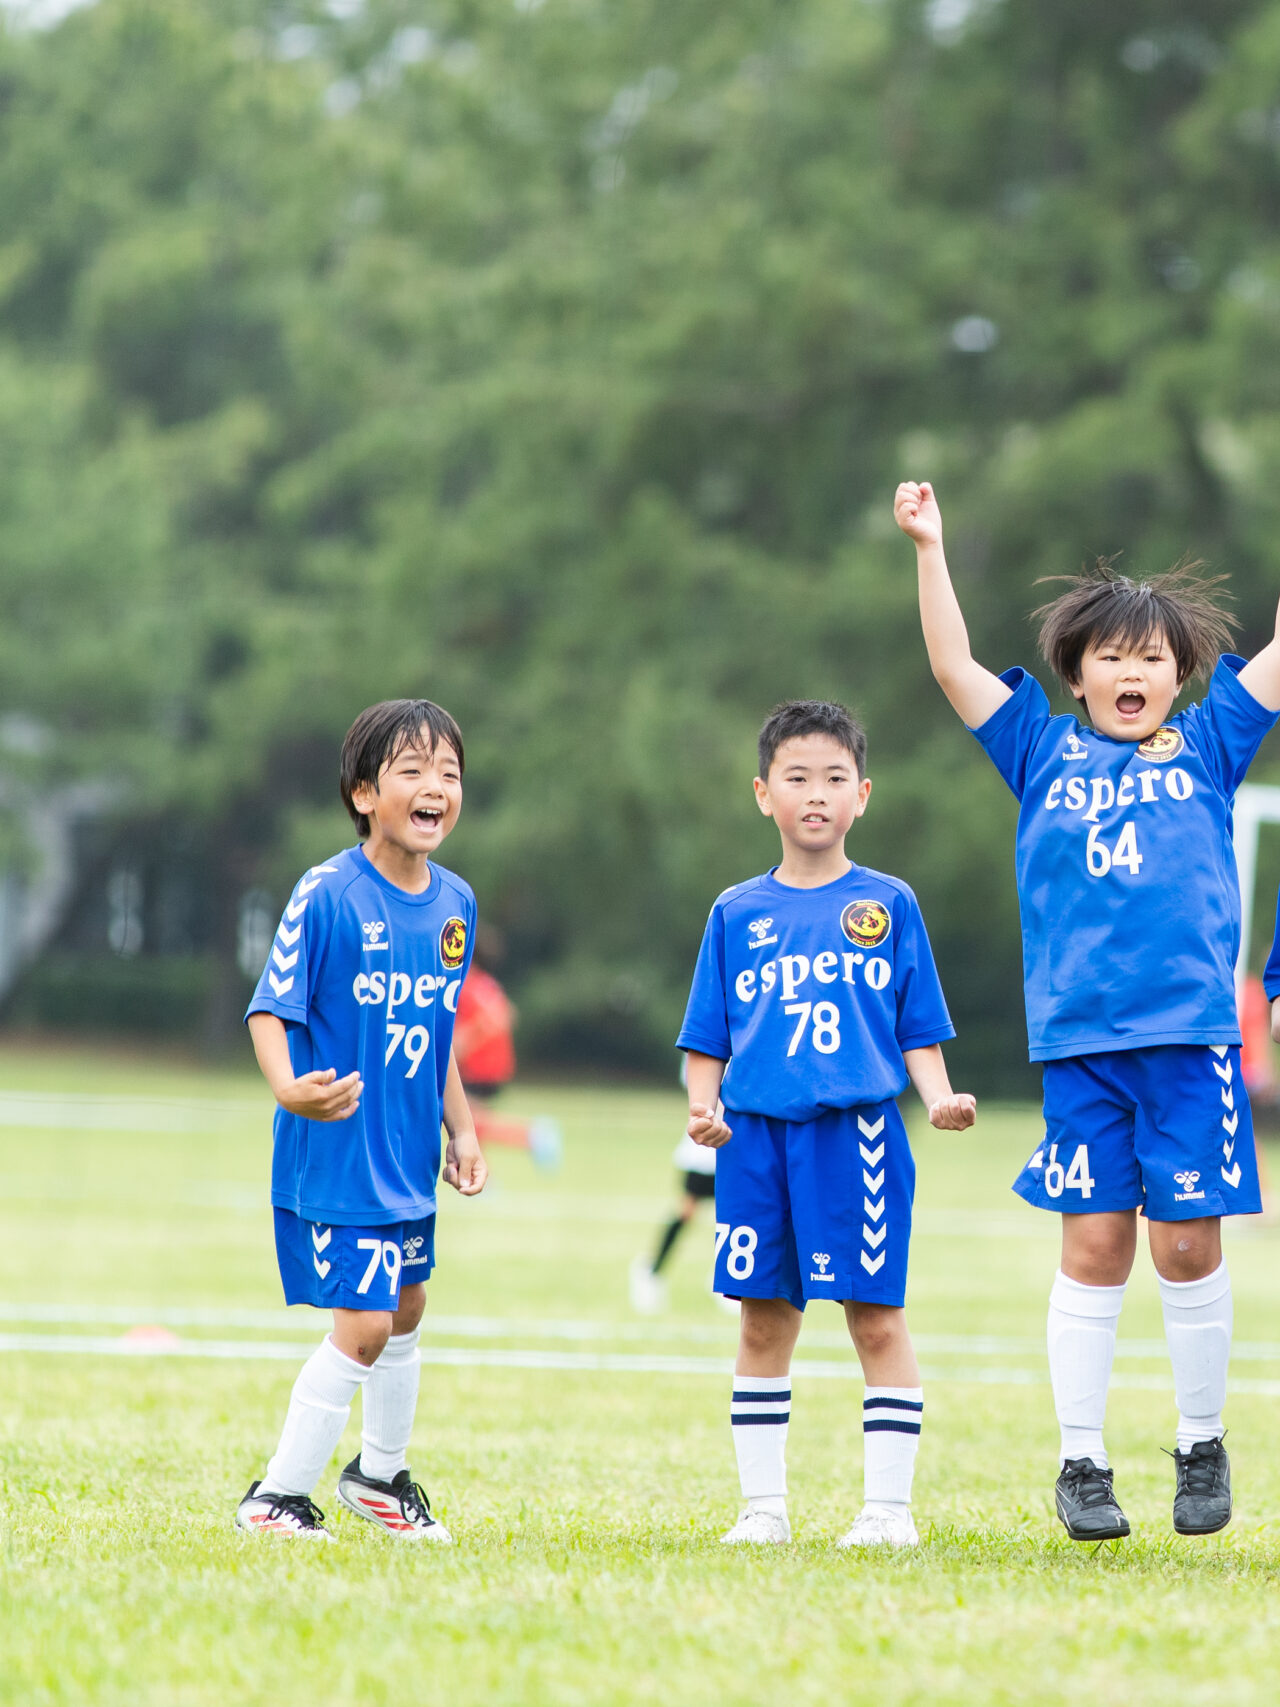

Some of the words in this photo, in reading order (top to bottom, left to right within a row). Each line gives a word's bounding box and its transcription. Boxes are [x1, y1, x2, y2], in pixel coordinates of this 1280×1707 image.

[1045, 768, 1194, 822] espero
[1086, 821, 1143, 877] 64
[735, 951, 891, 1003] espero
[385, 1024, 430, 1079] 79
[784, 1001, 840, 1057] 78
[1045, 1144, 1095, 1199] 64
[1174, 1190, 1205, 1202] hummel
[356, 1238, 401, 1295] 79
[402, 1254, 427, 1266] ummel
[715, 1223, 758, 1280] 78
